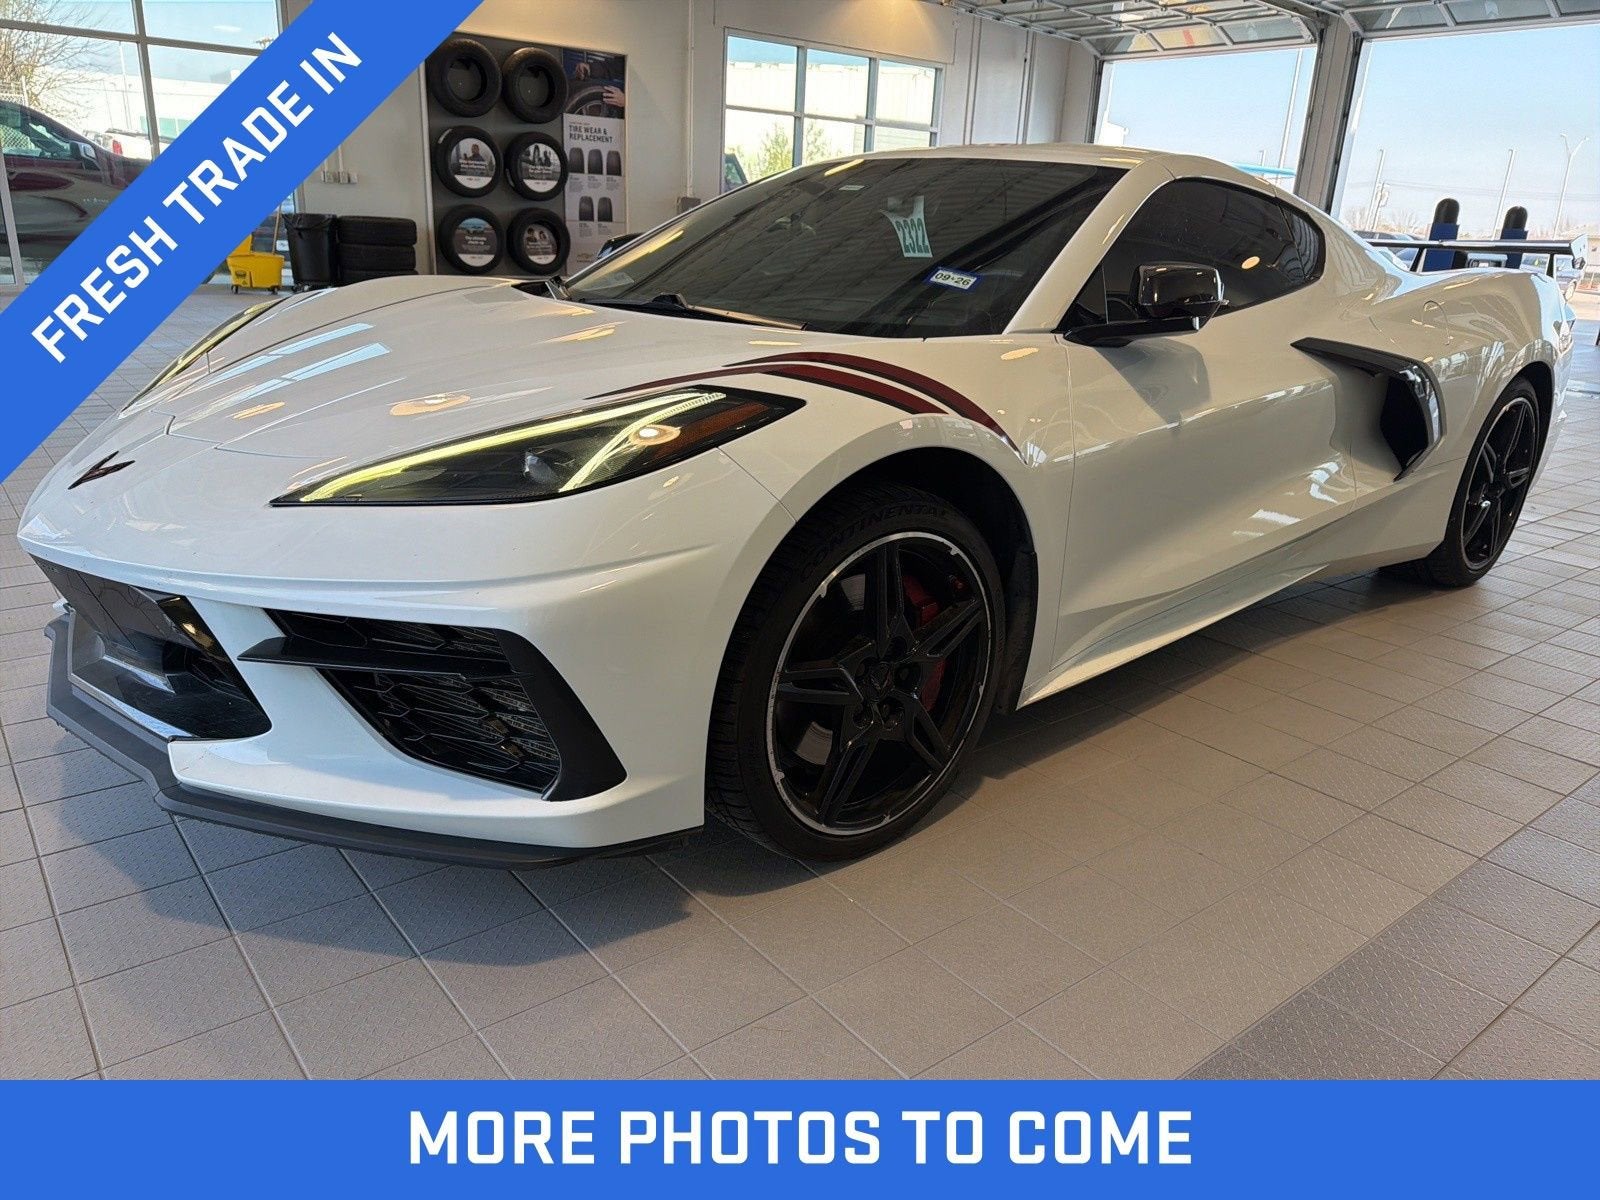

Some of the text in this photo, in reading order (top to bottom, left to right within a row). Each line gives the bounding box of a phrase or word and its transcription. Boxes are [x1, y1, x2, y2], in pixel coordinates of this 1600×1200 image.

[569, 125, 582, 133] TIRE
[584, 126, 602, 134] WEAR
[569, 133, 613, 144] REPLACEMENT
